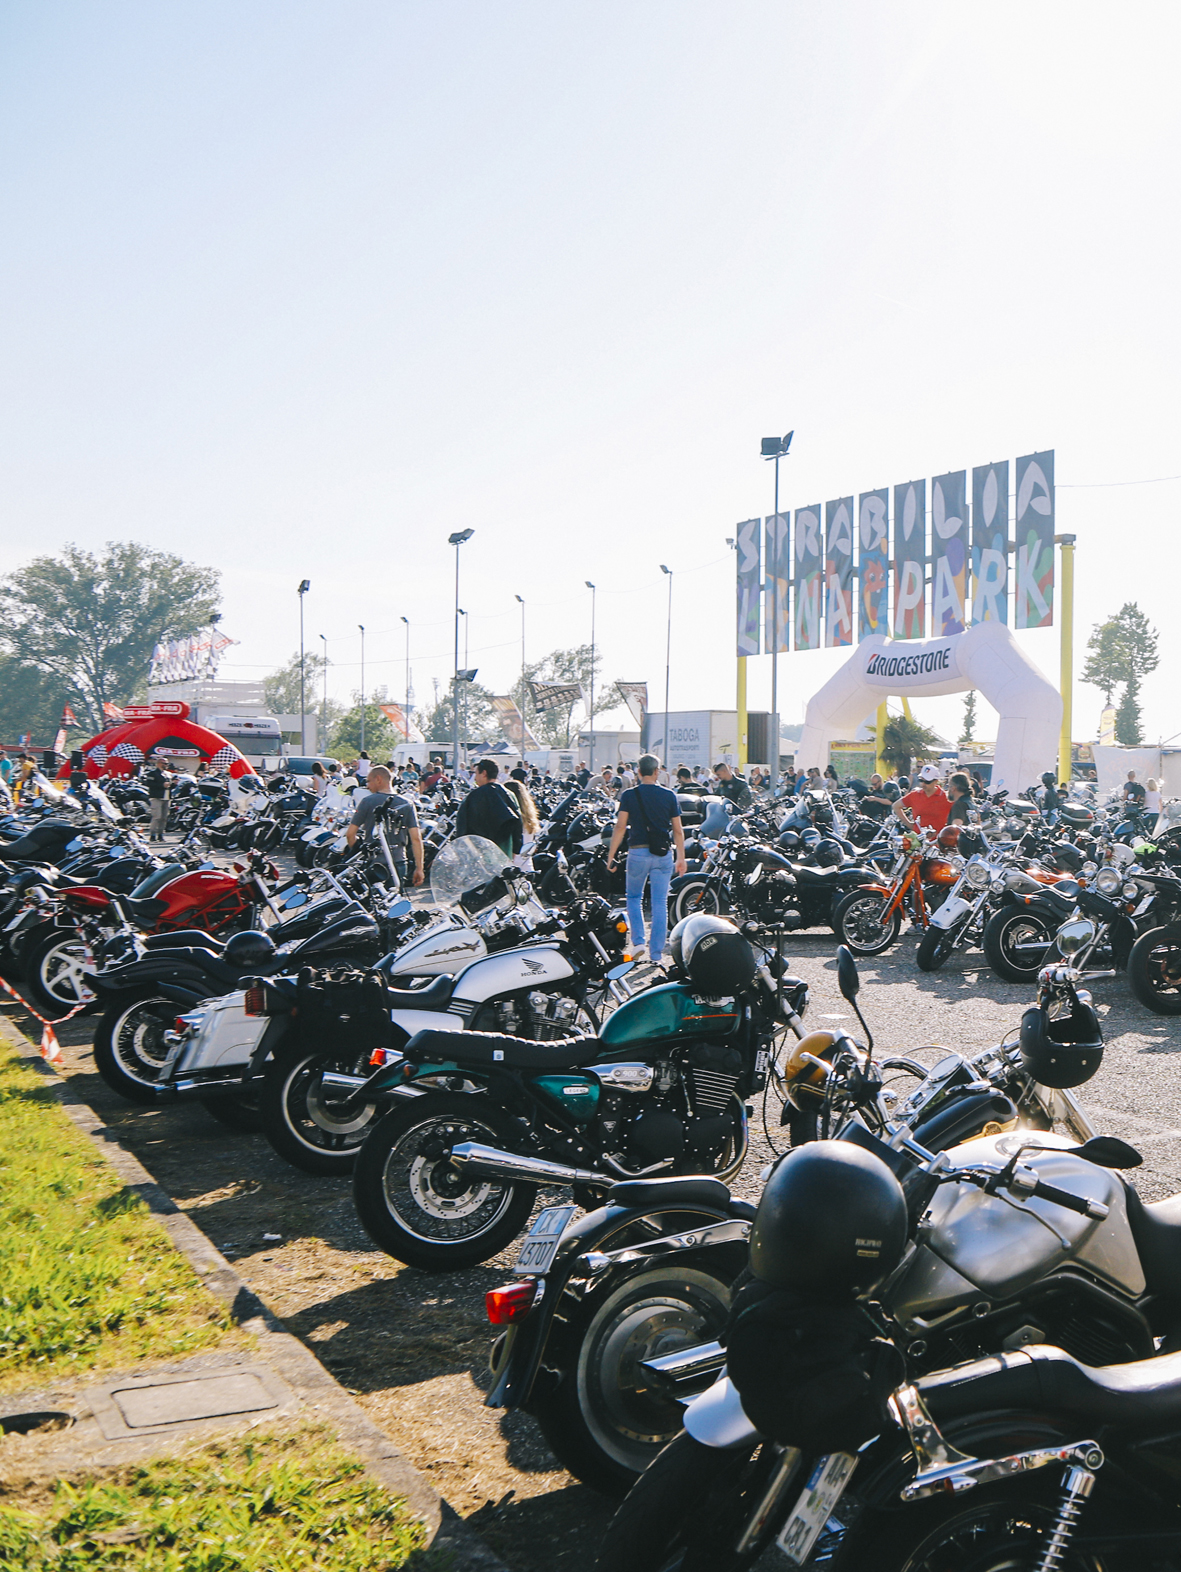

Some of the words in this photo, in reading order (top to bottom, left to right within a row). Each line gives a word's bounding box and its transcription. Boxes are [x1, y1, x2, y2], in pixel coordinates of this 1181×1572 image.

[738, 460, 1051, 573] STRABILIA
[738, 572, 851, 655] LUNA
[895, 539, 1051, 637] PARK
[866, 648, 951, 677] BRIDGESTONE
[669, 728, 700, 742] TABOGA
[520, 969, 548, 977] HONDA
[622, 1070, 637, 1078] 900
